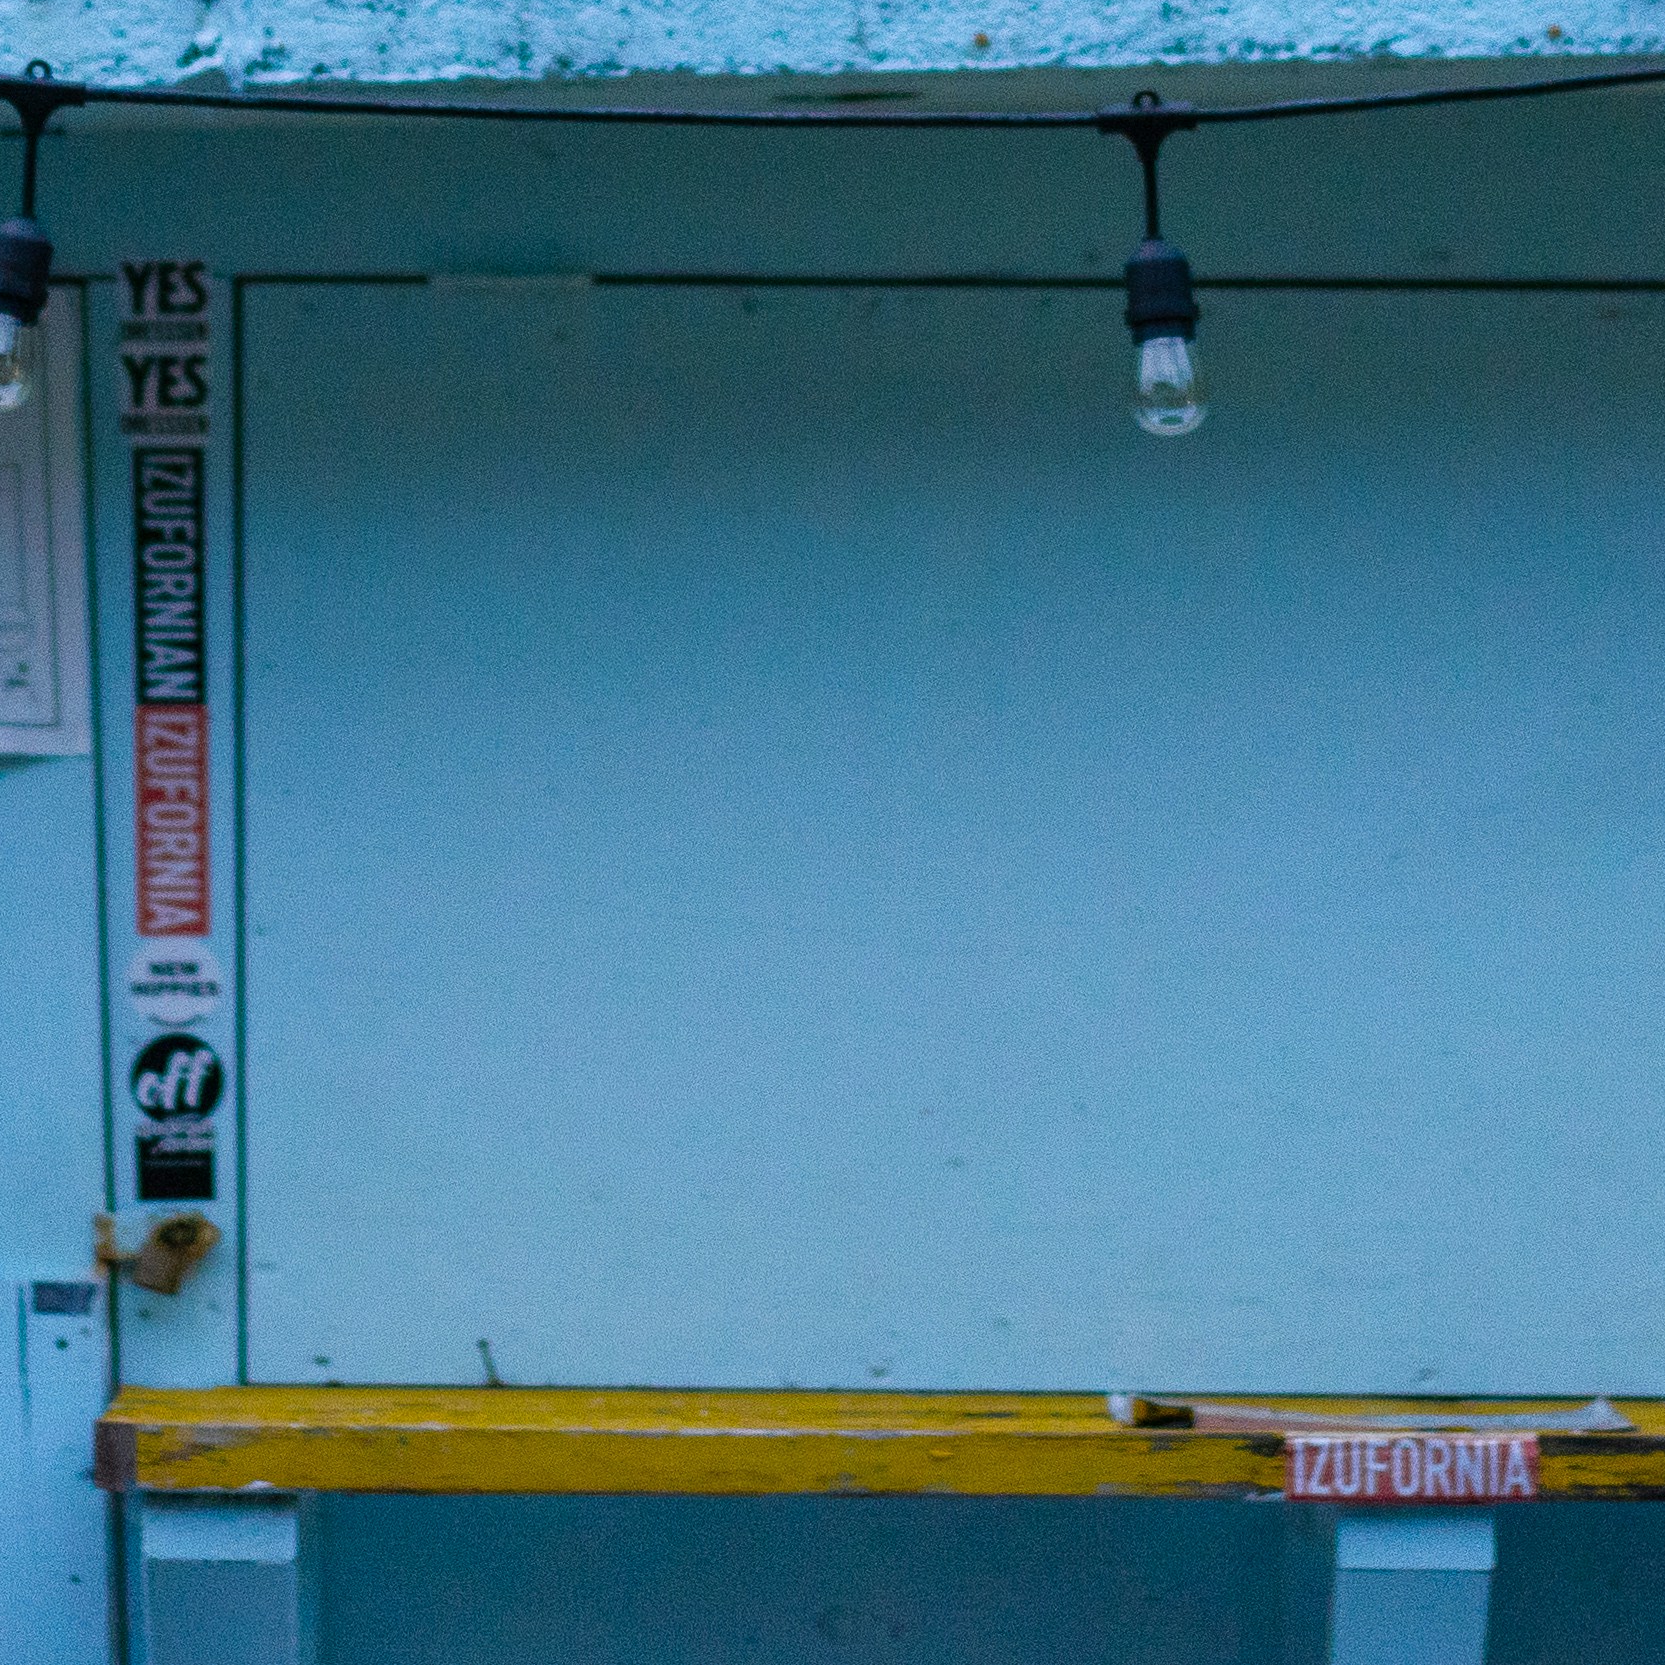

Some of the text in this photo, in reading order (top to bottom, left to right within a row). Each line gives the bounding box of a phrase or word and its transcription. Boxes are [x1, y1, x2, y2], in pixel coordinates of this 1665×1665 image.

[121, 262, 209, 313] YES
[121, 355, 209, 407] YES
[140, 452, 199, 699] IZUFORNIAN
[143, 712, 205, 934] IZUFORNIA
[1290, 1437, 1533, 1497] IZUFORNIA
